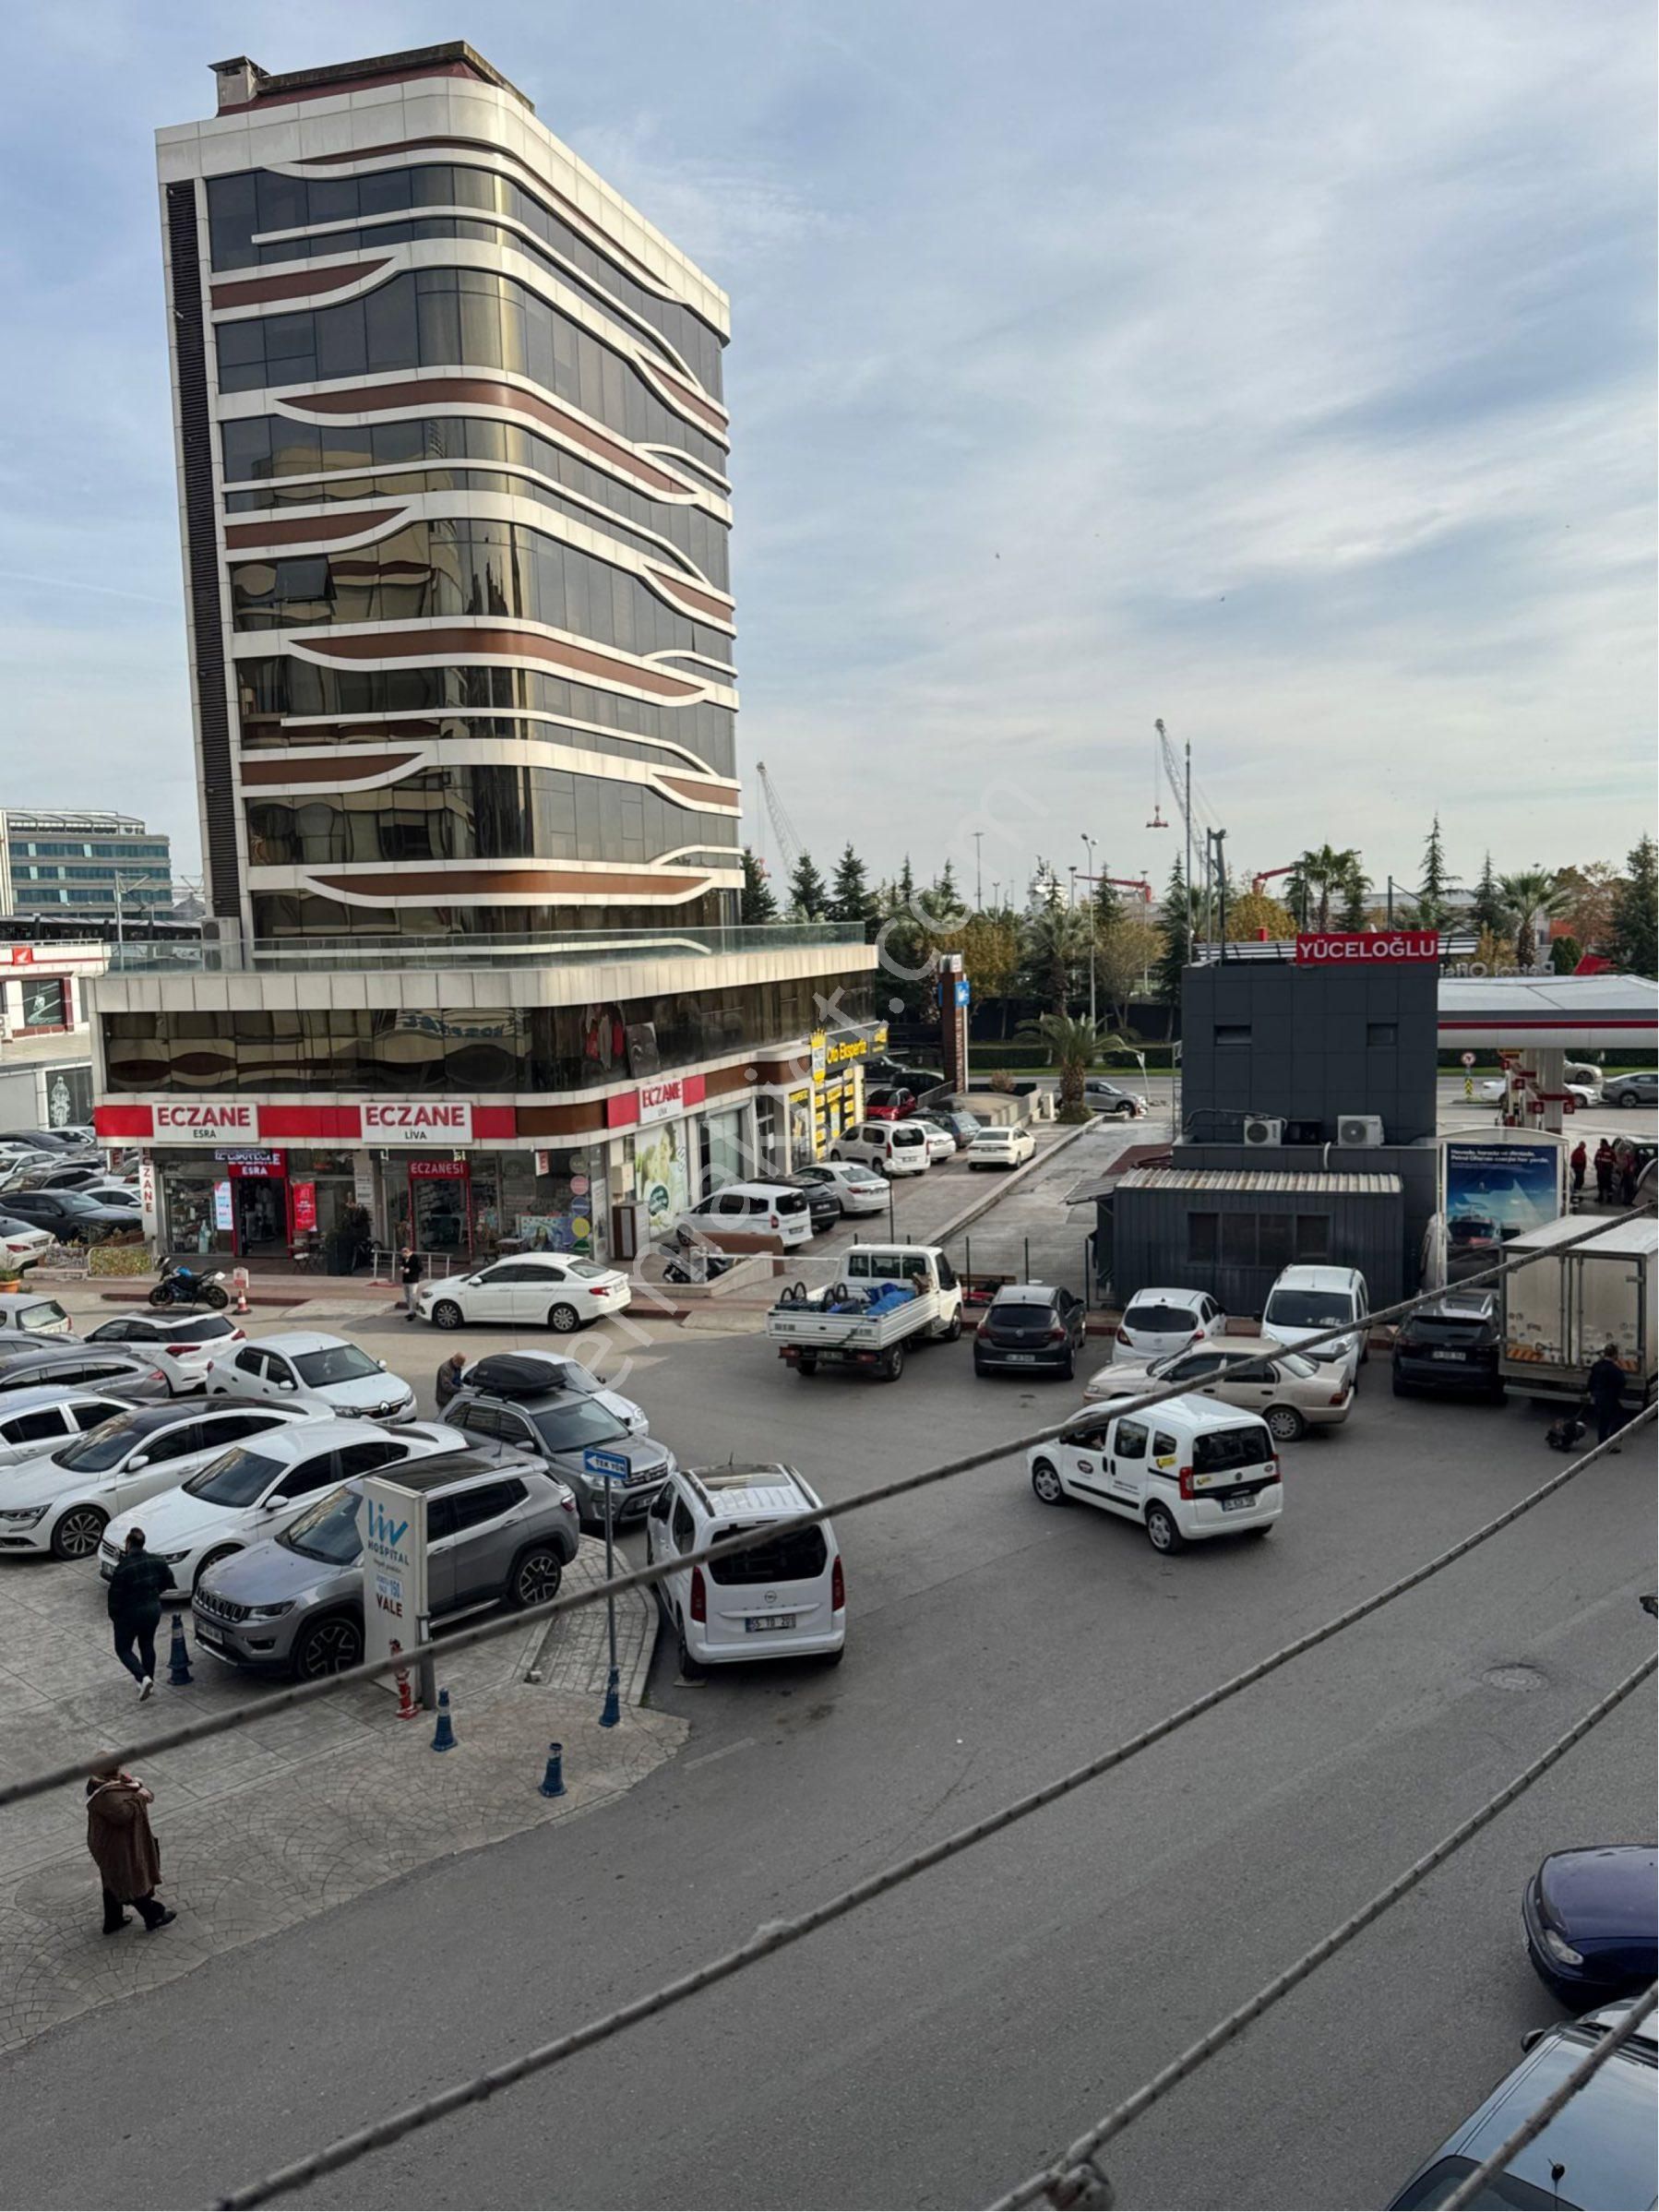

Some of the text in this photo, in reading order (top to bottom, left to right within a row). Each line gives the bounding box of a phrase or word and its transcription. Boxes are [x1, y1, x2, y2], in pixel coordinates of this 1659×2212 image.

[1299, 937, 1436, 959] YÜCELOĞLU
[642, 1082, 681, 1107] ECZANE
[157, 1106, 251, 1127] ECZANE
[366, 1106, 465, 1127] ECZANE
[193, 1130, 216, 1138] ESRA
[404, 1130, 427, 1140] LİVA
[242, 1166, 268, 1176] ESRA
[596, 1458, 609, 1467] TEK
[368, 1499, 409, 1547] liv
[367, 1539, 410, 1566] HOSPITAL
[376, 1593, 402, 1618] VALE
